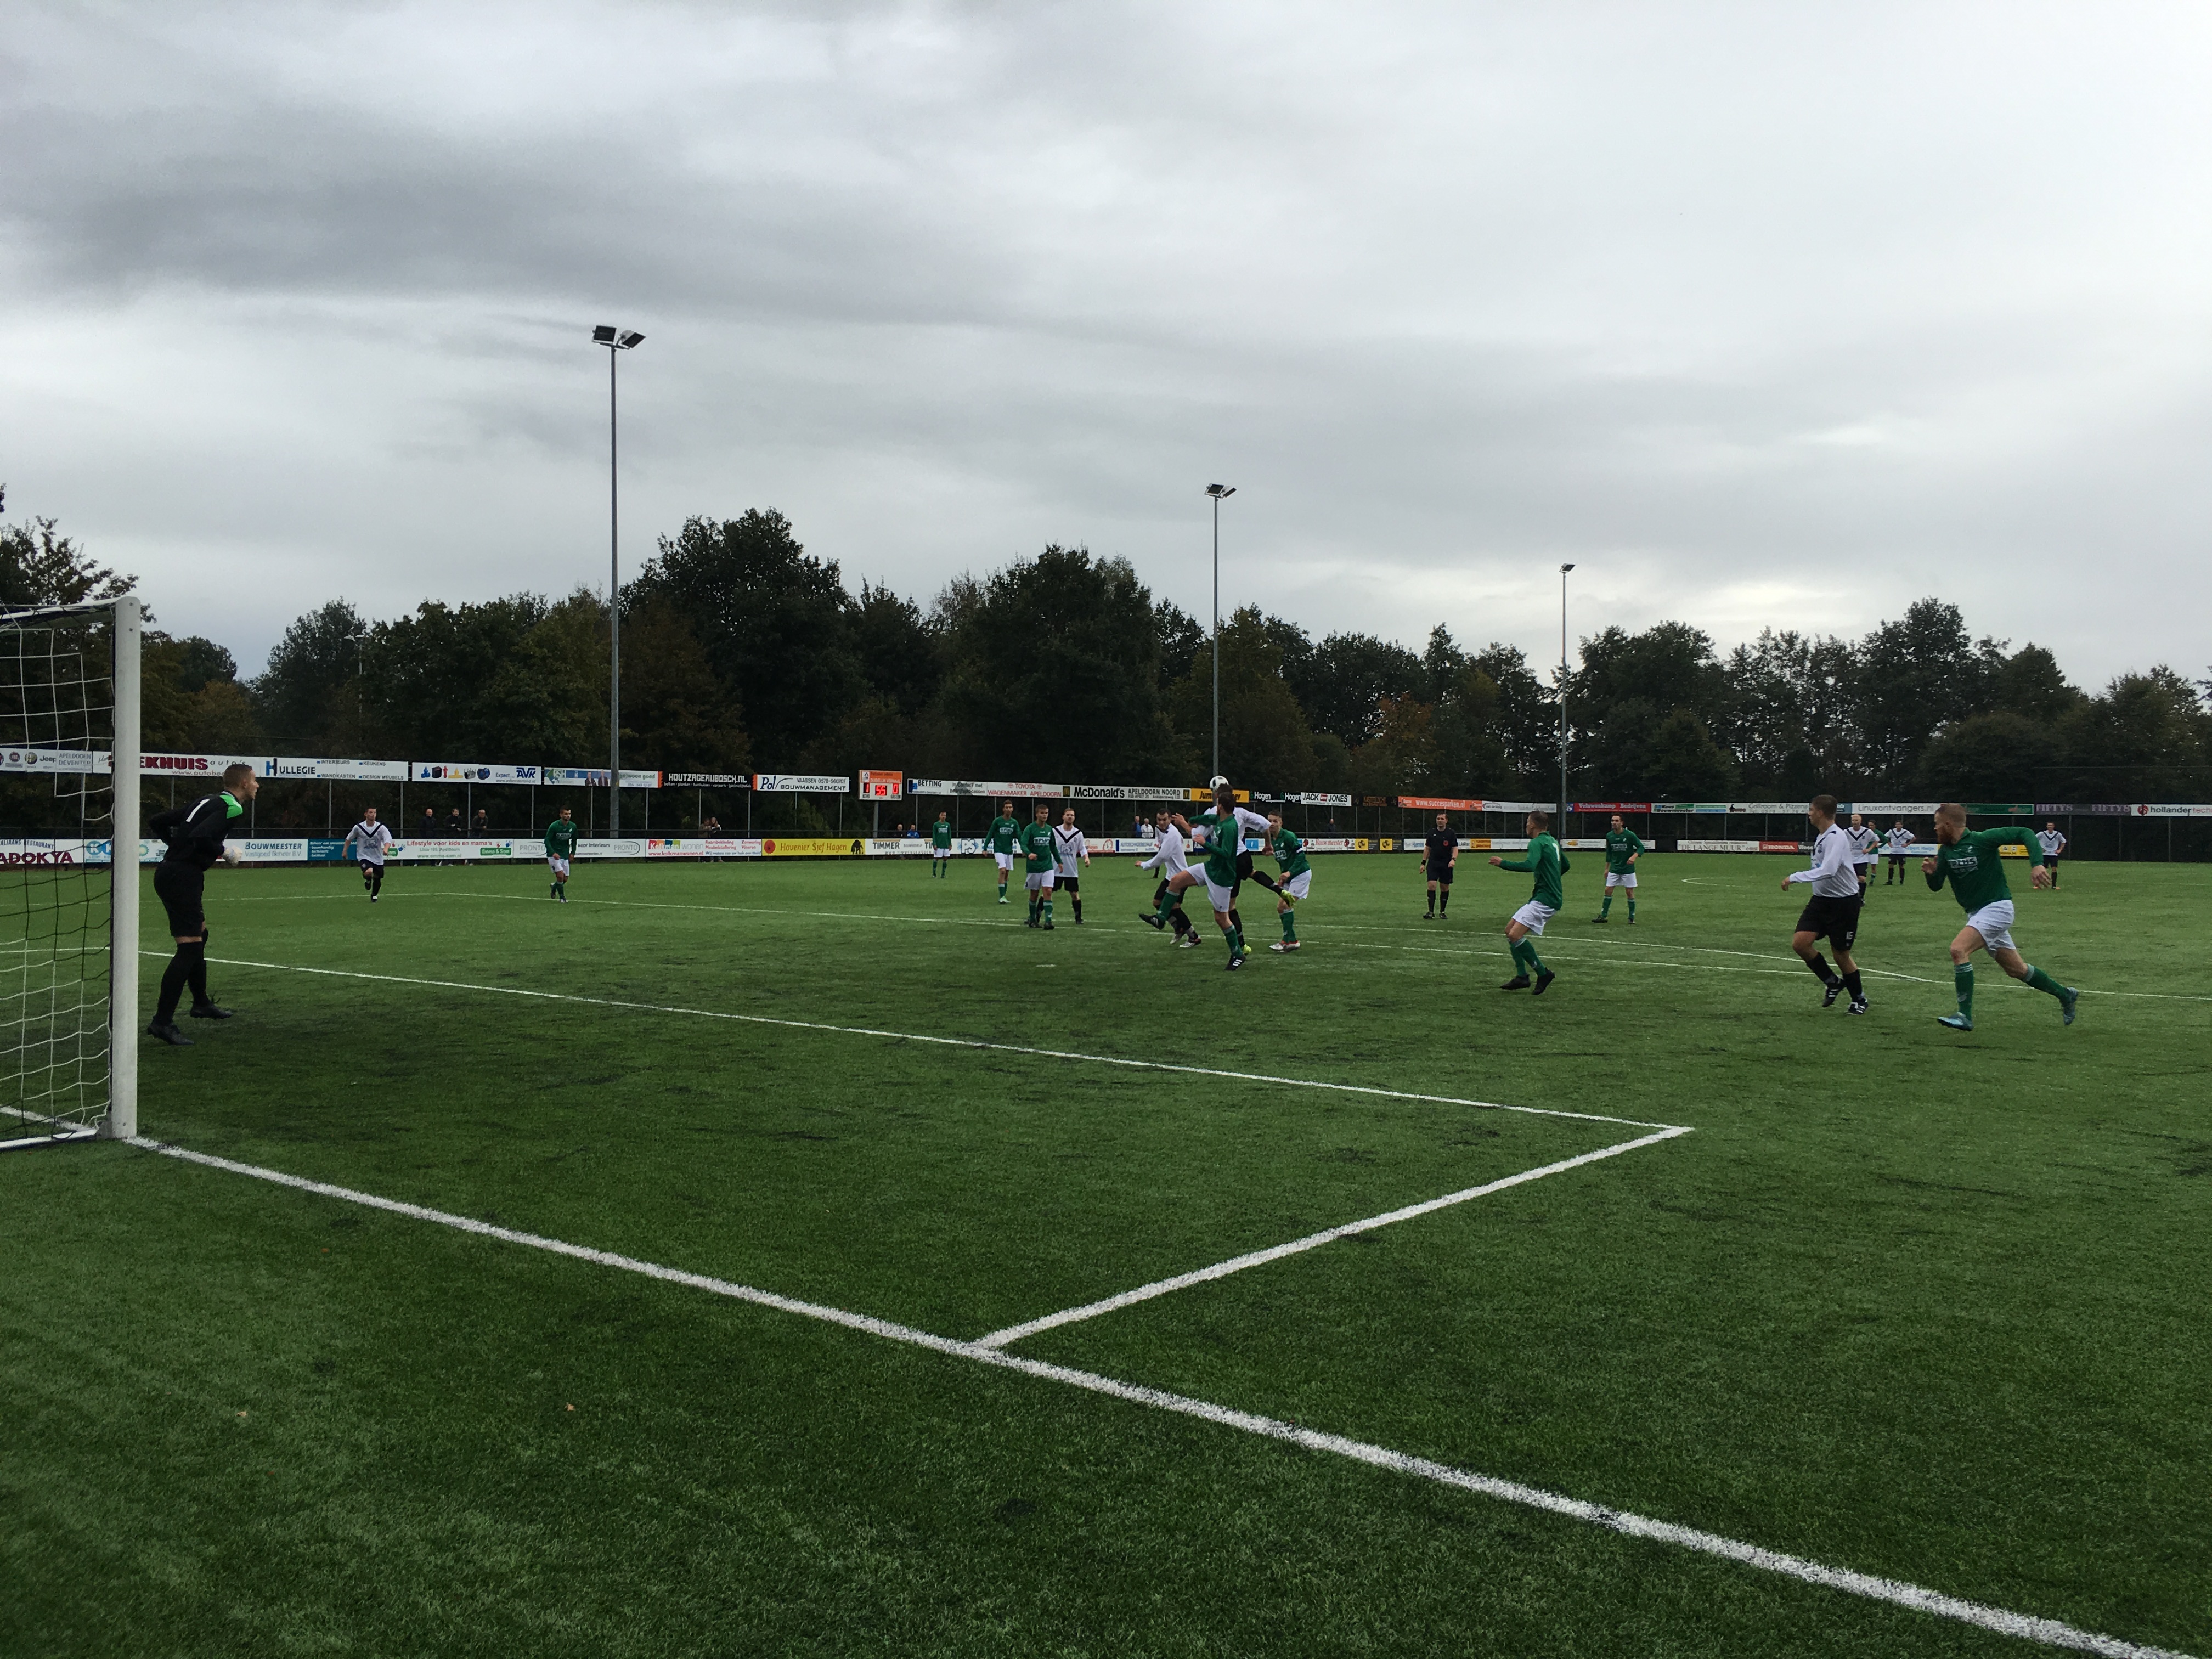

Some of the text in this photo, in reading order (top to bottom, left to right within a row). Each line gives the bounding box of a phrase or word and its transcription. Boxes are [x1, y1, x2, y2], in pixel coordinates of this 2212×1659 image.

[760, 775, 776, 790] Pol
[918, 779, 942, 787] BETTING
[876, 785, 886, 796] 55
[893, 783, 899, 794] 0
[1074, 787, 1125, 798] McDonald's
[1858, 804, 1934, 813] Linuxontvangers.nl
[2151, 806, 2192, 815] hollander
[780, 843, 810, 851] Hovenier
[826, 843, 847, 853] Hagen
